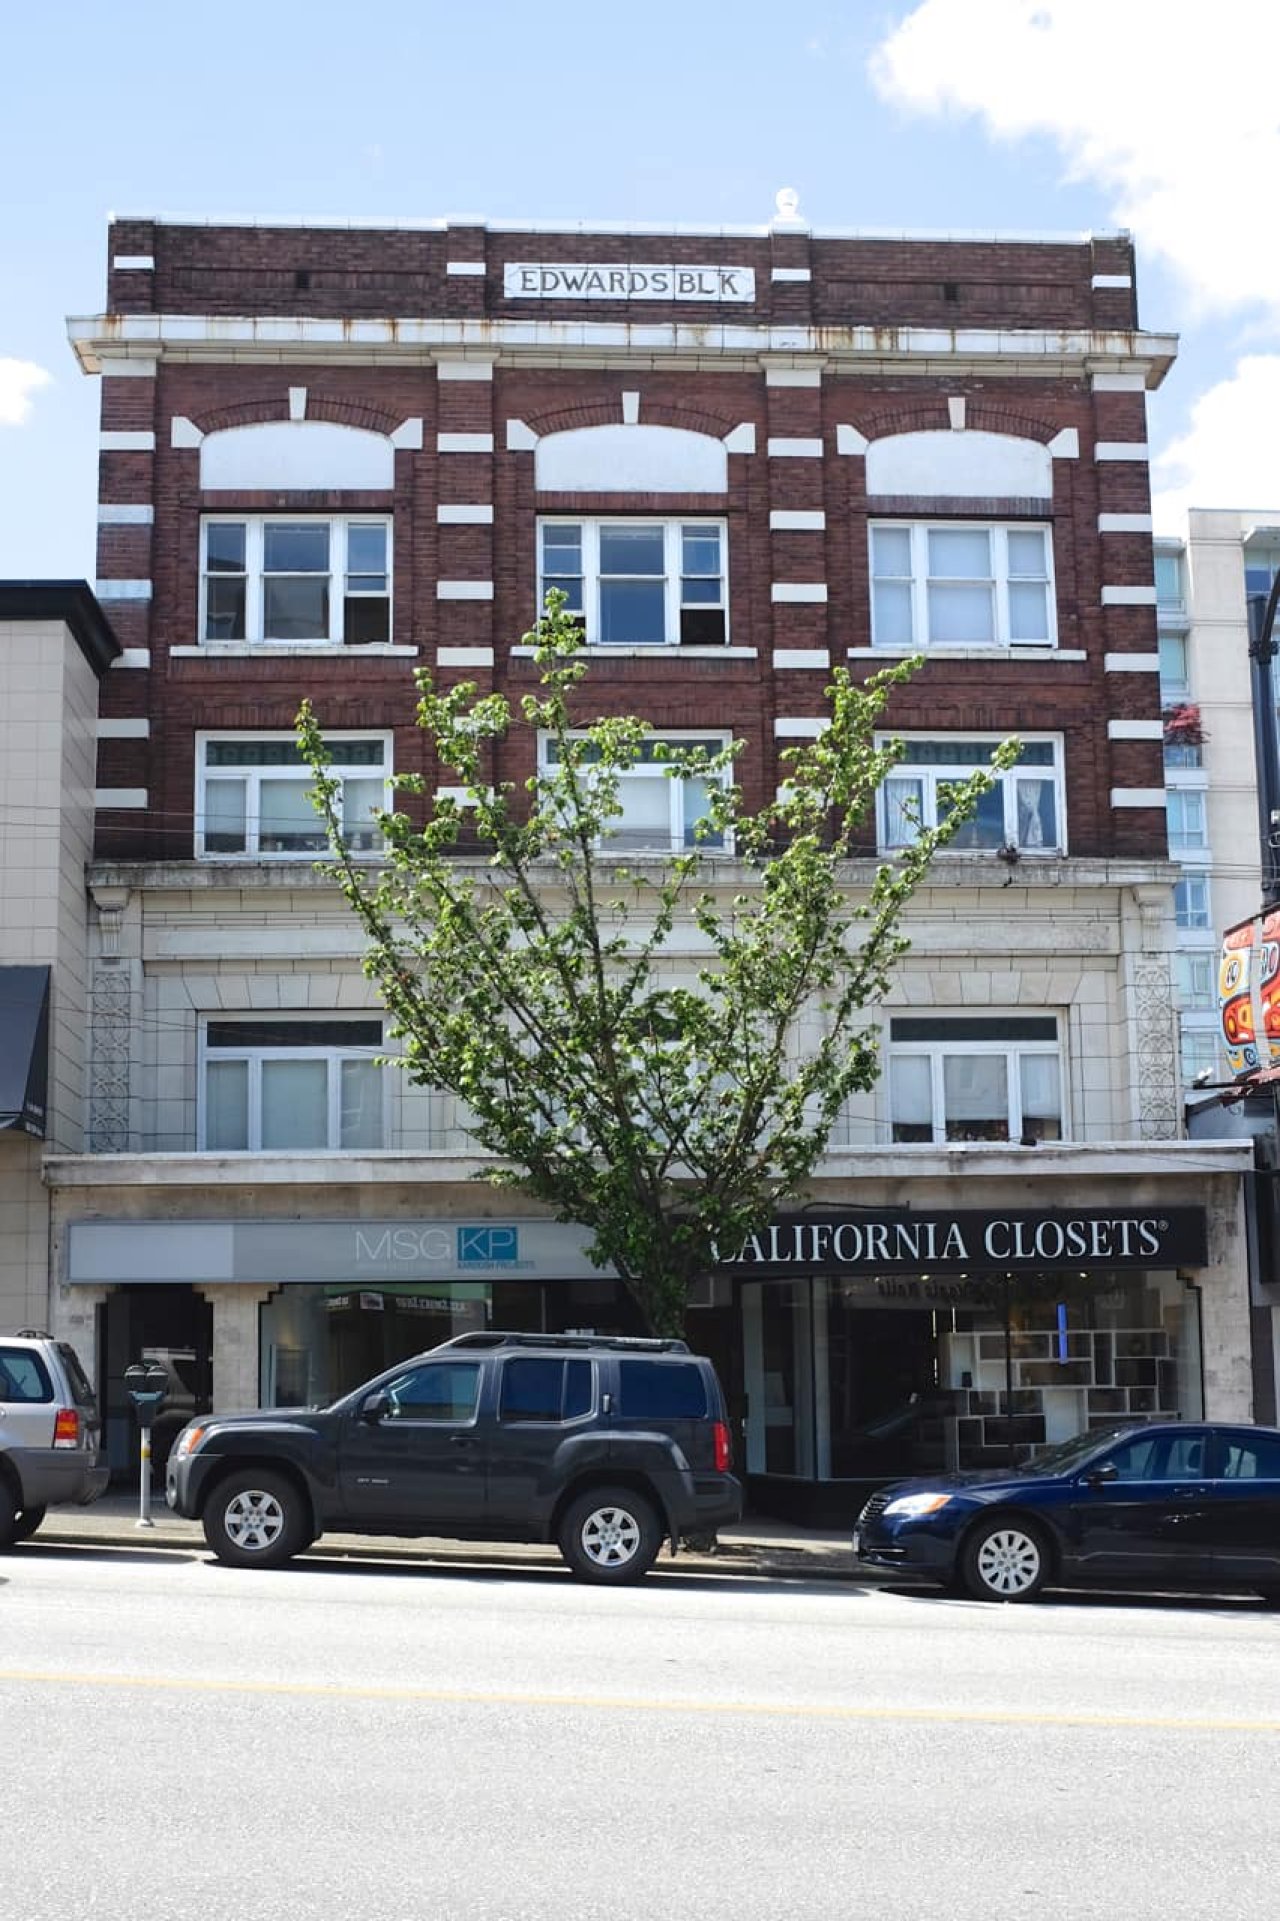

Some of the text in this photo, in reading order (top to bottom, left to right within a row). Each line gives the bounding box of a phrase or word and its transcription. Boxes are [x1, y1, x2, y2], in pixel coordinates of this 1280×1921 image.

[521, 270, 739, 296] EDWARDS BLK
[355, 1228, 514, 1261] MSG KP
